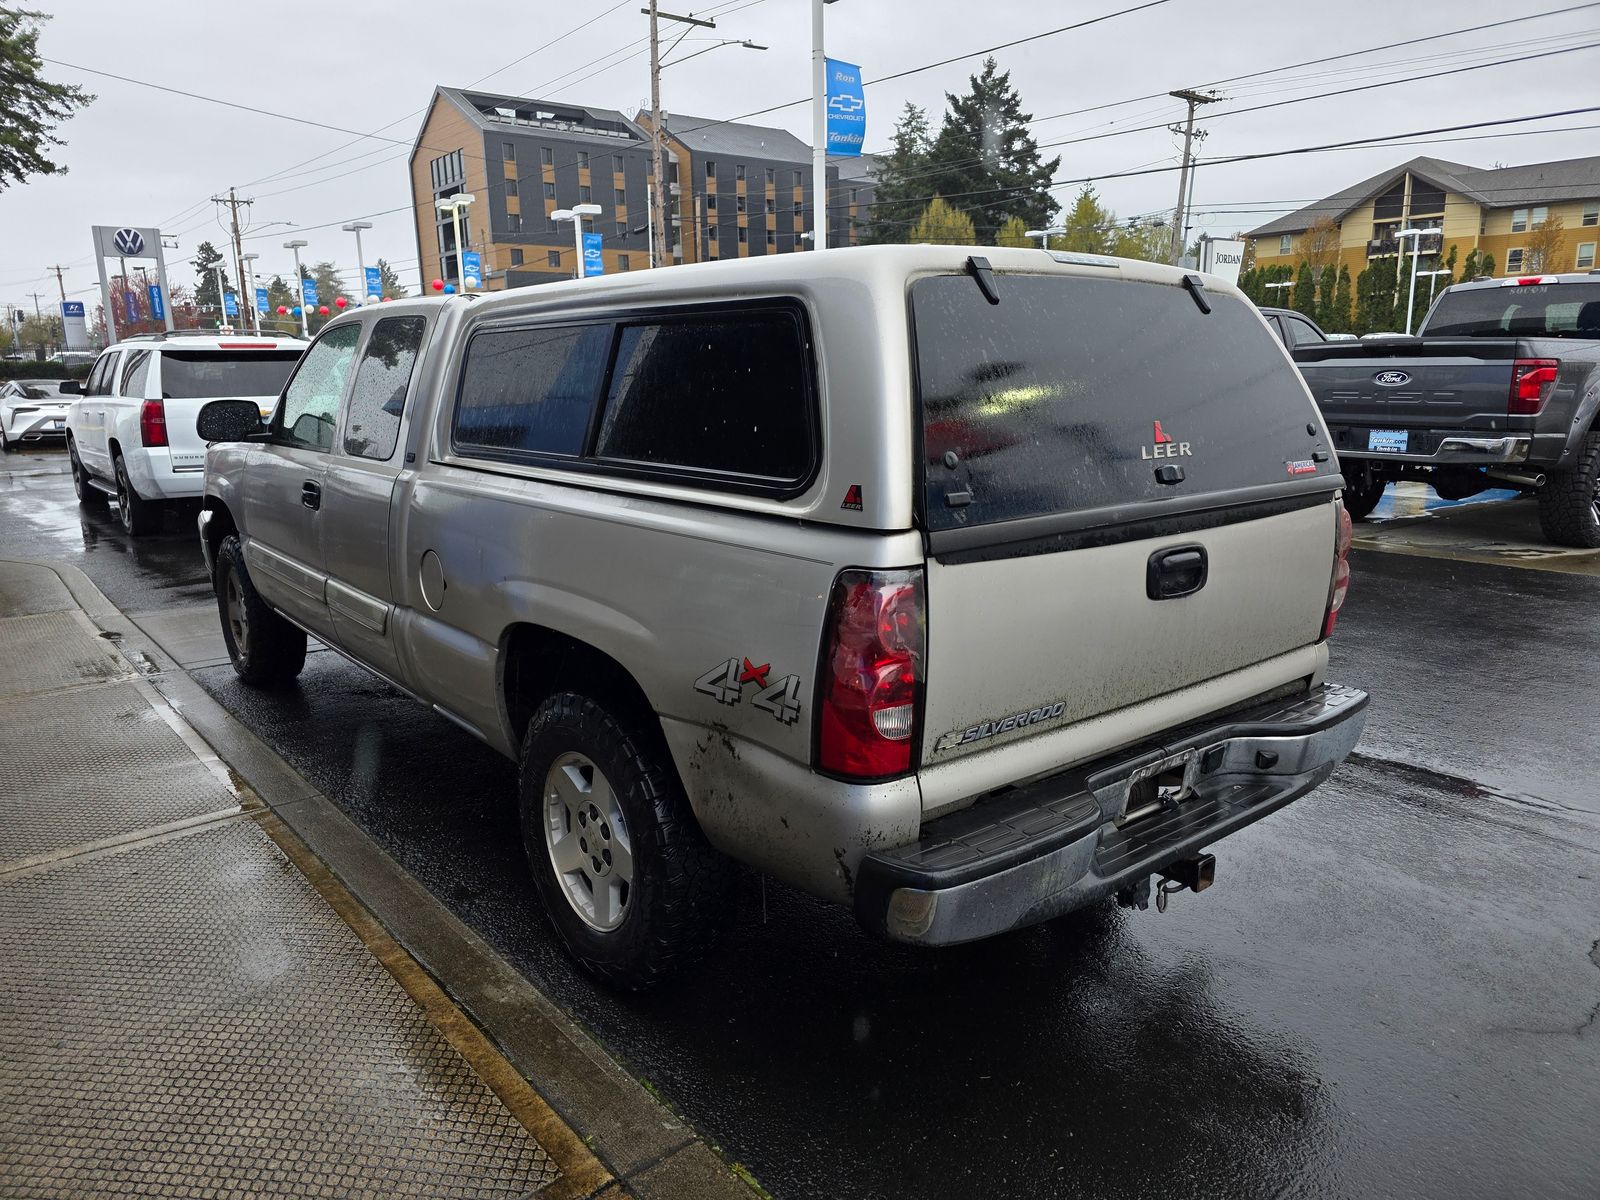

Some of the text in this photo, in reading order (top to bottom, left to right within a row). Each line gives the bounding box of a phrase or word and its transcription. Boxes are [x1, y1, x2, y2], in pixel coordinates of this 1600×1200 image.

[835, 72, 855, 83] Ron
[828, 113, 864, 122] CHEVROLET
[829, 132, 863, 144] Tonkin
[1215, 252, 1241, 265] JORDAN
[1381, 372, 1403, 383] Ford
[1141, 442, 1193, 460] LEER
[843, 502, 862, 510] LEER
[961, 701, 1067, 744] SILVERADO
